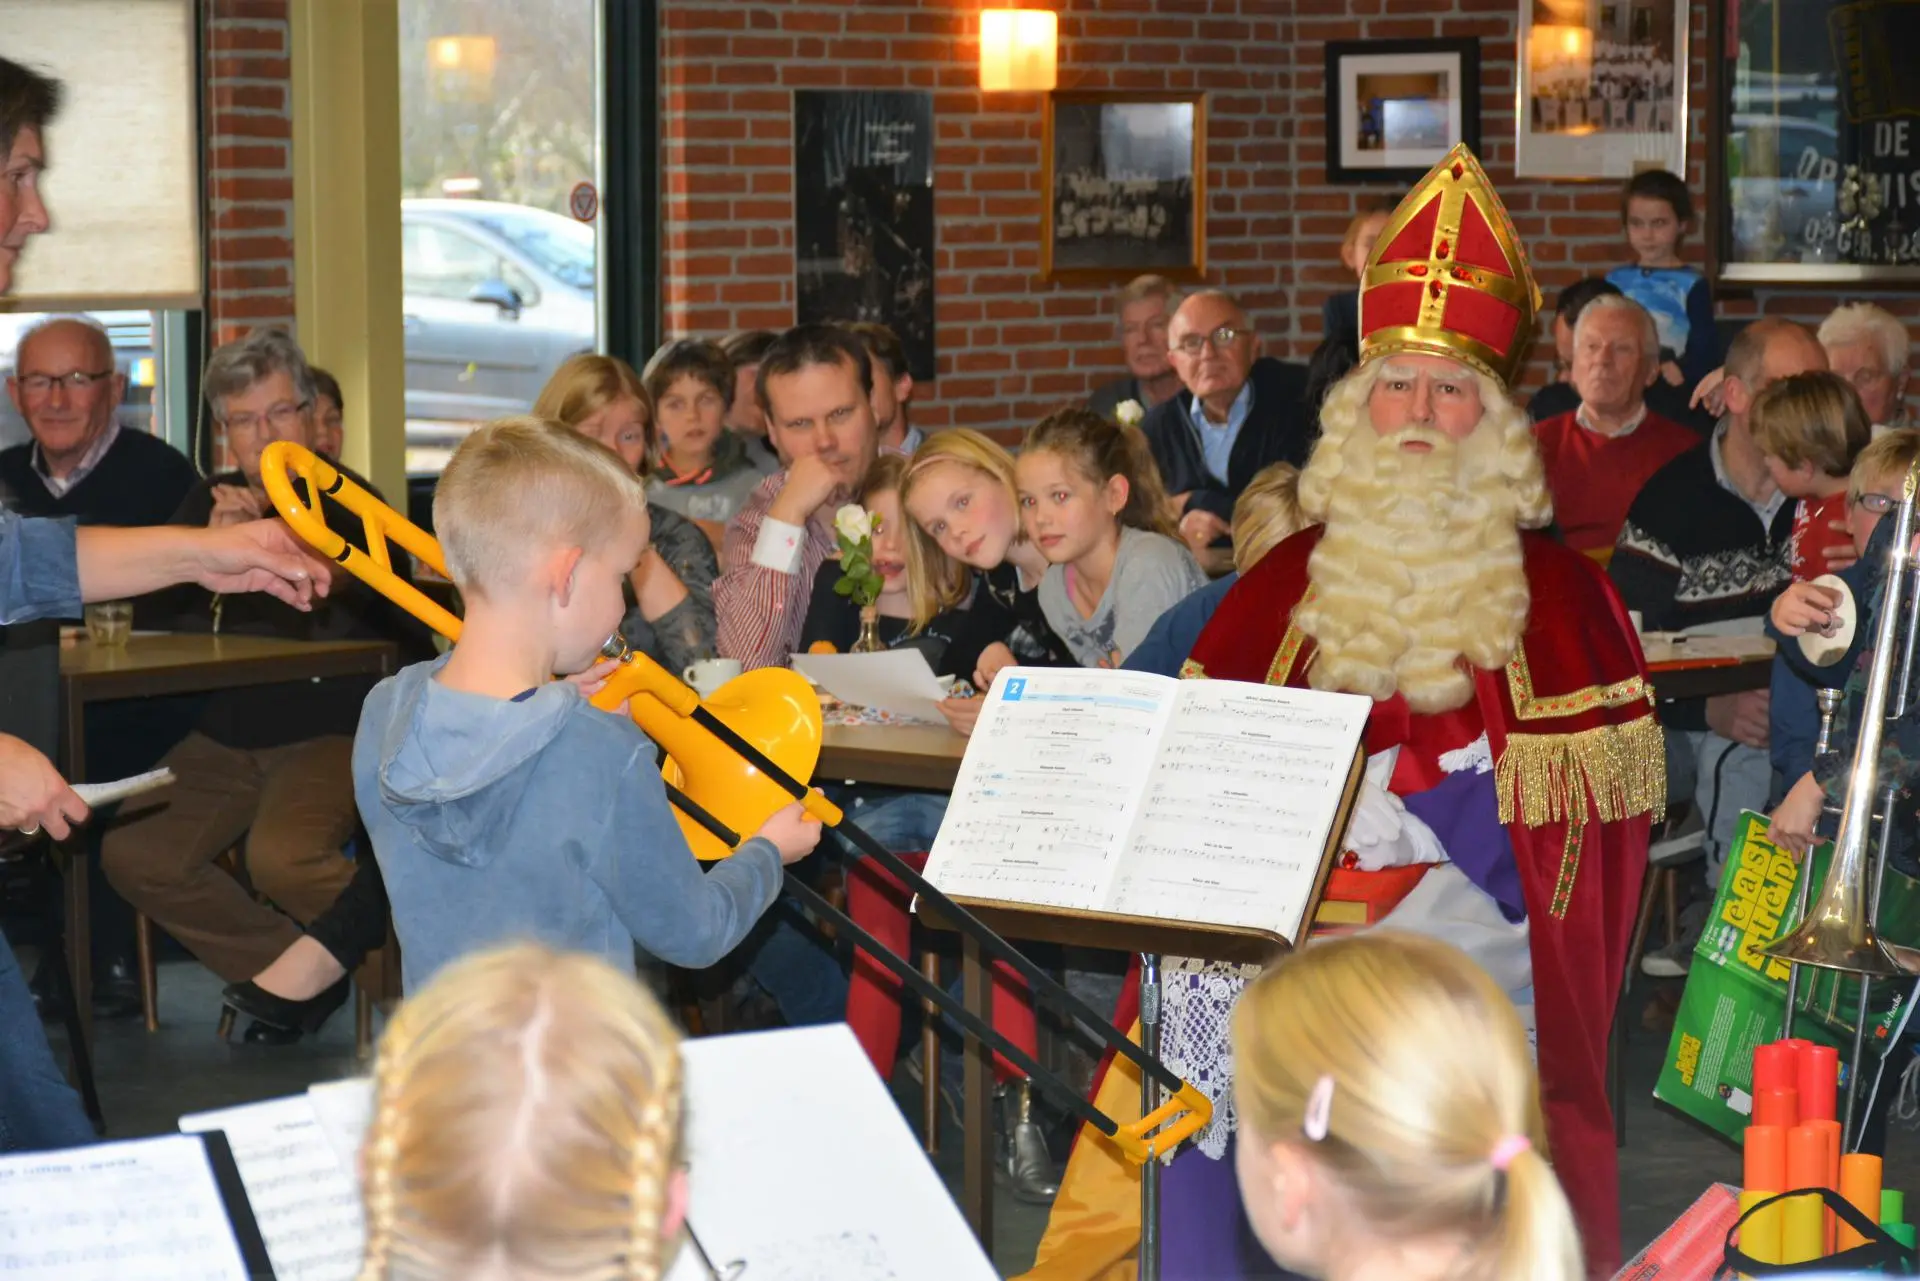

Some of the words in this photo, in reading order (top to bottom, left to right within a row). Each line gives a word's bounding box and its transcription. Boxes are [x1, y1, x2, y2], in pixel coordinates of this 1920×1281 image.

[1874, 120, 1910, 157] DE
[1010, 682, 1020, 695] 2
[1744, 848, 1796, 961] step
